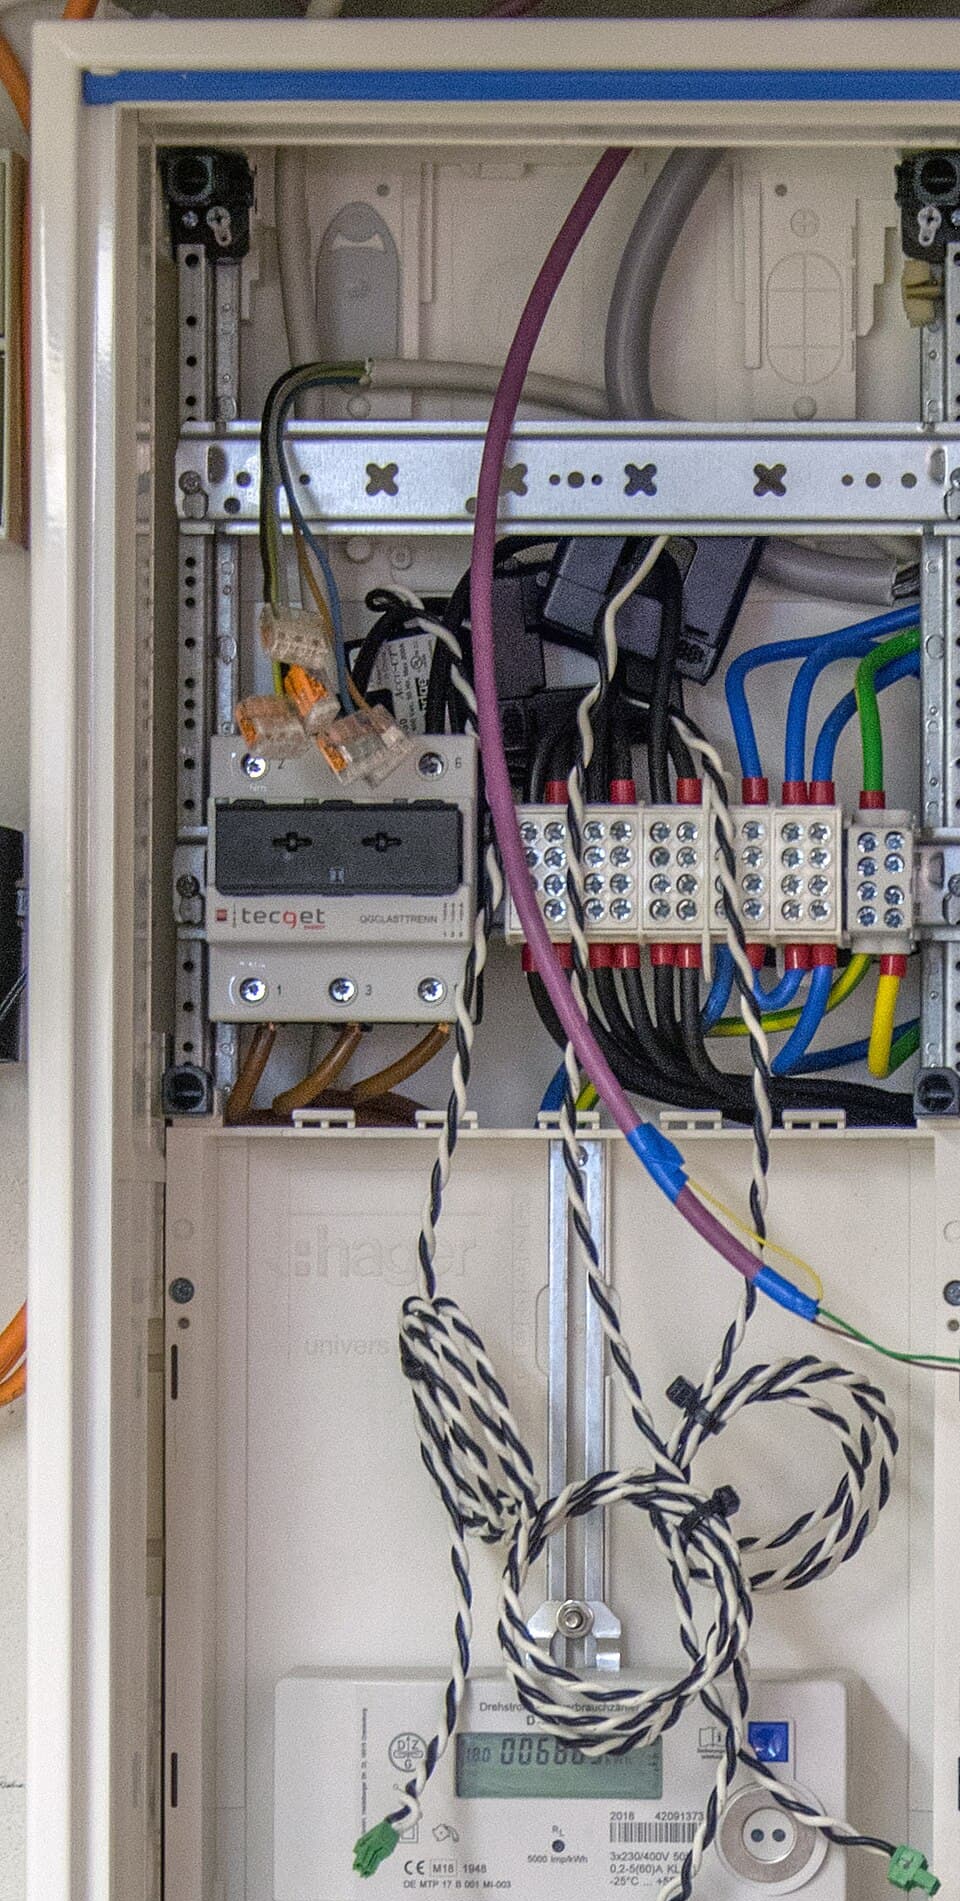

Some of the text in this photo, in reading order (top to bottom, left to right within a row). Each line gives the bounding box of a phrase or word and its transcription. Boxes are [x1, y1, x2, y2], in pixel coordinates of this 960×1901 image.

[242, 907, 326, 929] tecget
[610, 1812, 704, 1821] 2018 42091373
[527, 1855, 548, 1864] 5000
[404, 1880, 416, 1888] DE
[420, 1880, 439, 1888] MTP
[442, 1880, 452, 1888] 17
[464, 1880, 480, 1888] 001
[483, 1880, 512, 1888] MI-003
